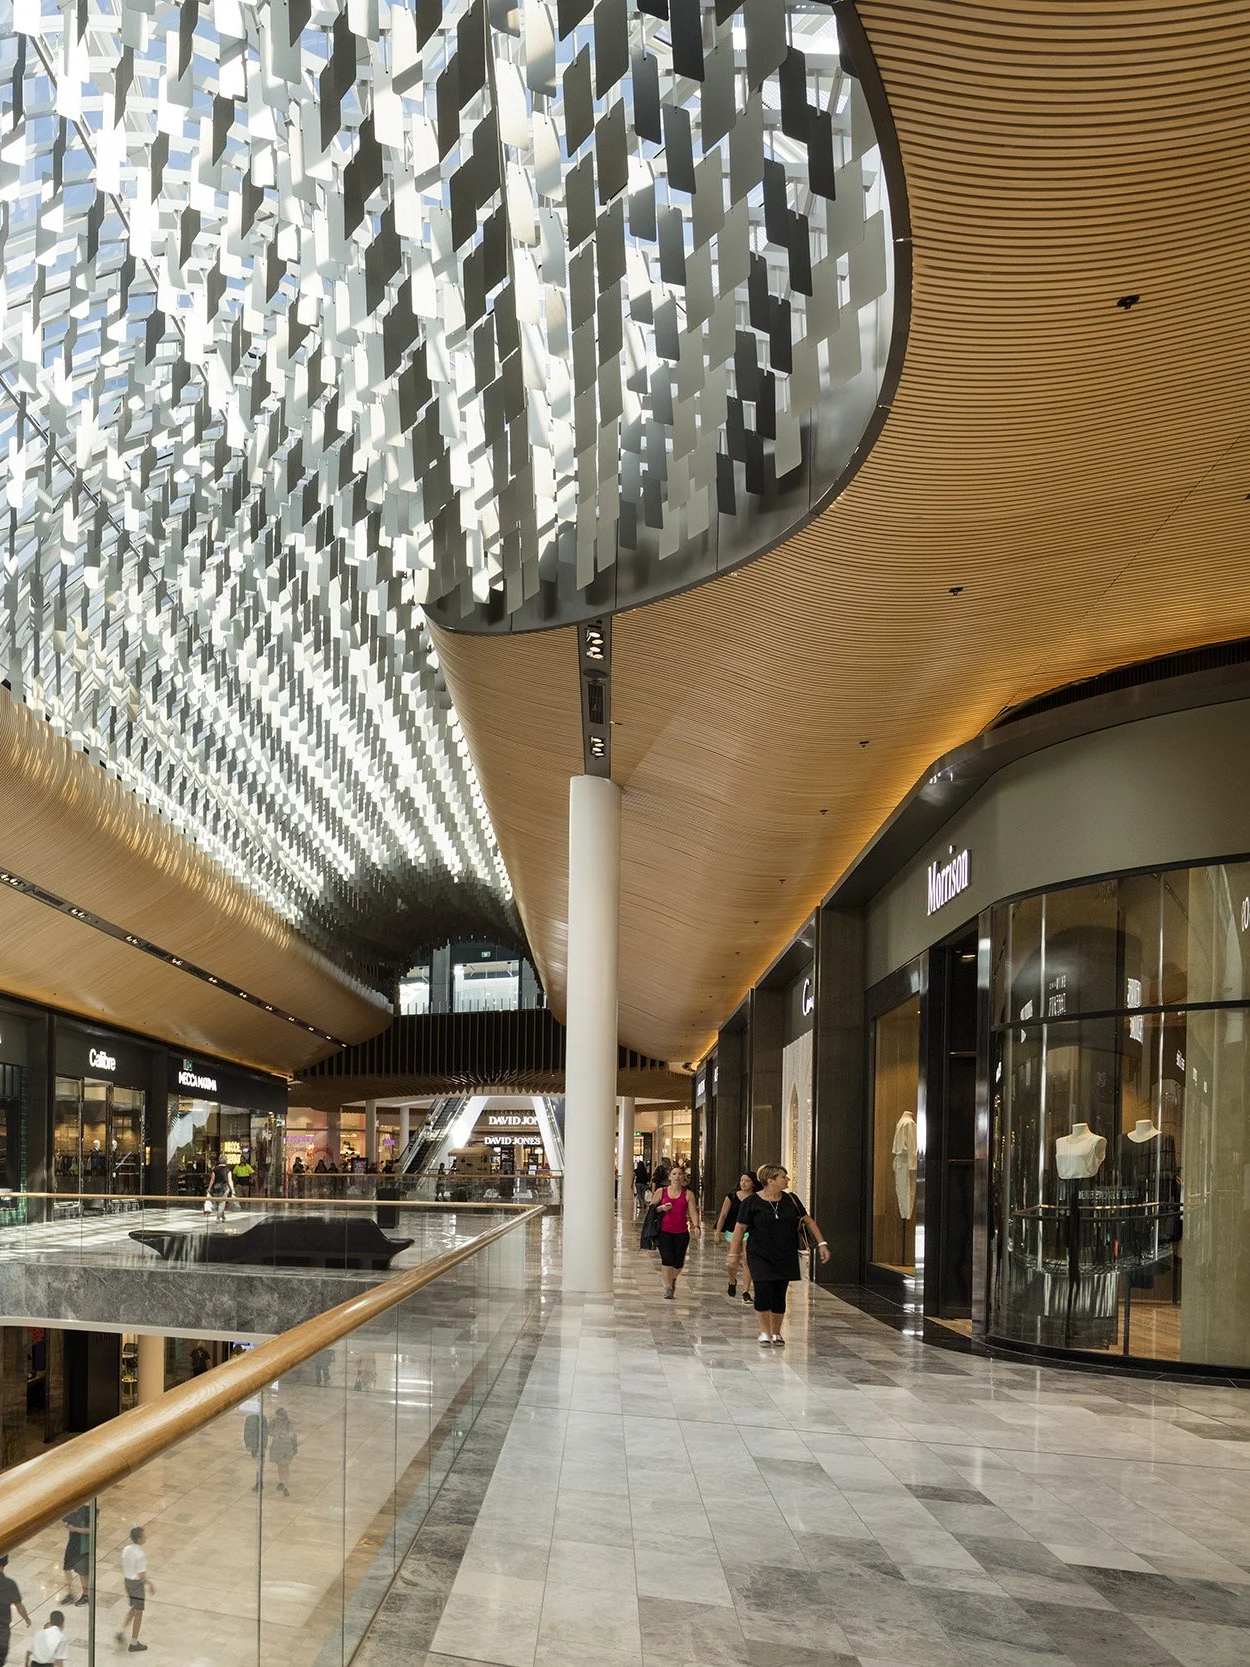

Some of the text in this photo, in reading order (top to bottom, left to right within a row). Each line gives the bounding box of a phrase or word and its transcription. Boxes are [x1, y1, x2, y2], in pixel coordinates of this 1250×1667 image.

[927, 845, 969, 916] Morrison
[488, 1116, 521, 1125] DAVID
[484, 1136, 541, 1145] DAVID JONES
